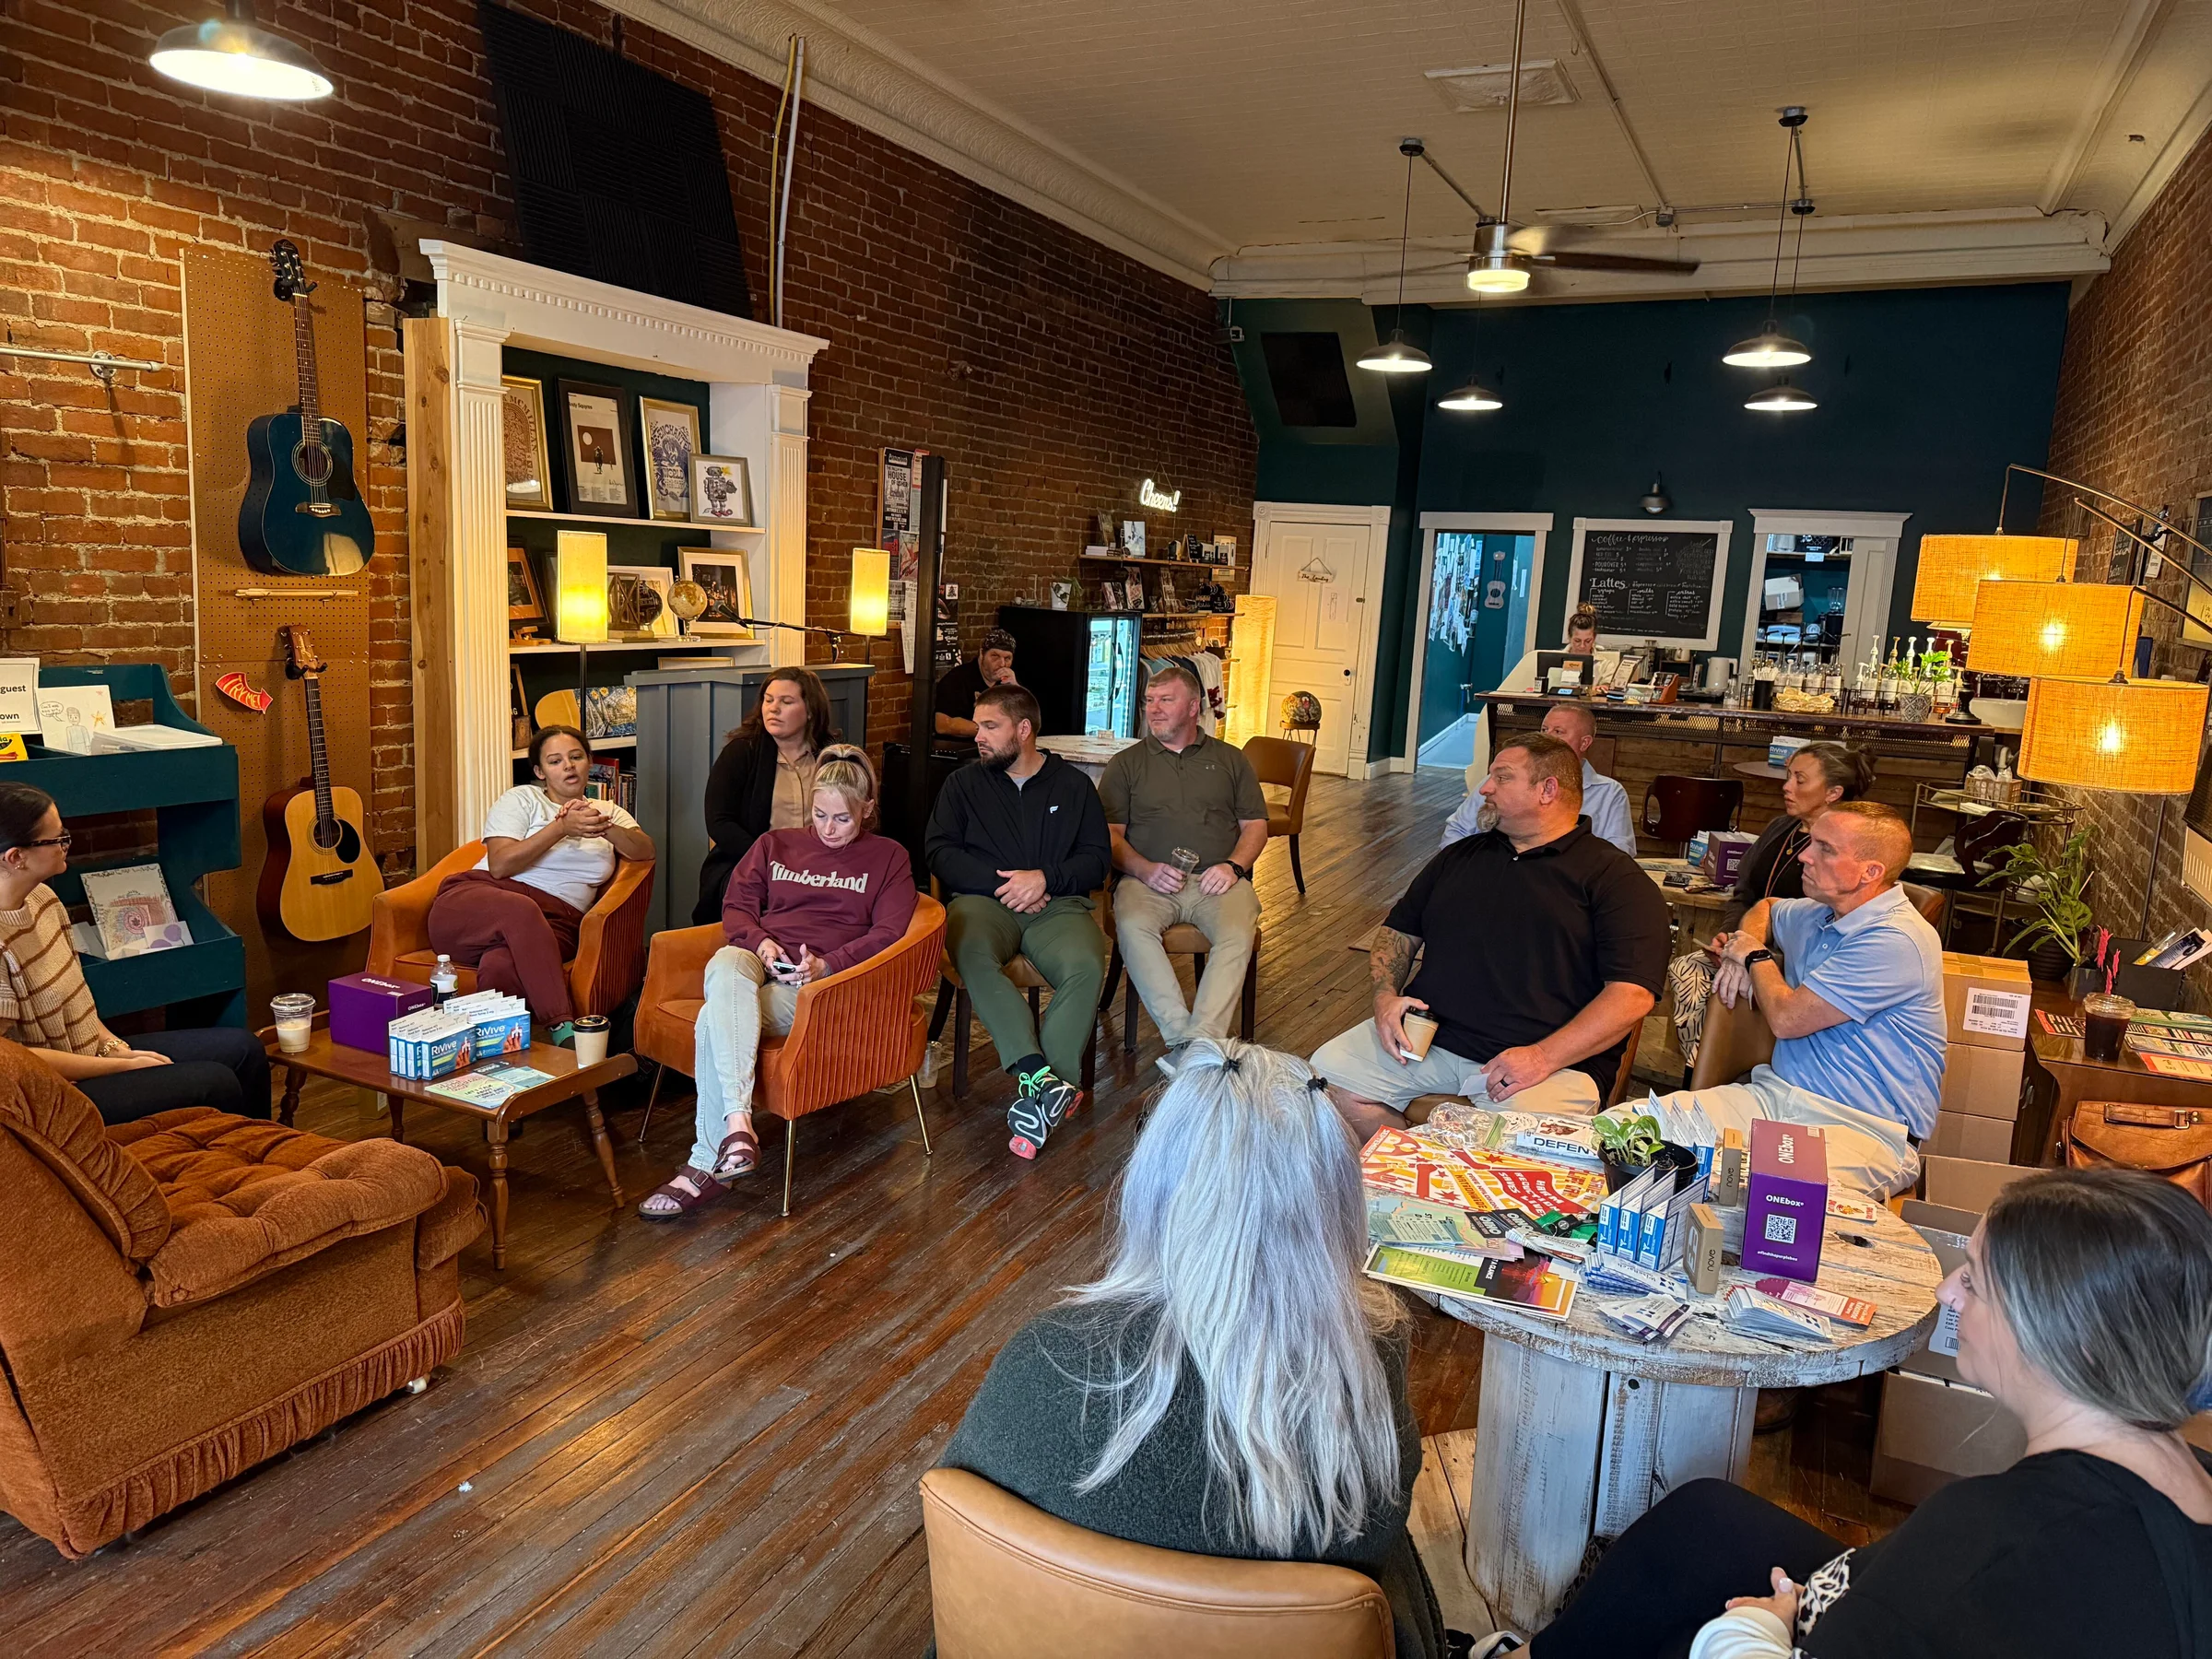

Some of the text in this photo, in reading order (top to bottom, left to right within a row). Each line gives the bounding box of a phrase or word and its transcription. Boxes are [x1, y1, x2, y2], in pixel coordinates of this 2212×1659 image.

[664, 467, 684, 480] WORLD
[888, 471, 906, 481] HOUSE
[1140, 478, 1181, 512] Cheers!
[1590, 578, 1626, 590] Lattes
[223, 675, 248, 701] TRY
[770, 860, 868, 893] Timberland
[431, 1041, 457, 1055] RiVive
[1534, 1137, 1595, 1156] DEFEN
[1454, 1174, 1488, 1209] NATIONWIDE
[1499, 1171, 1521, 1194] SAVES
[1514, 1172, 1561, 1212] REDUCTION
[1535, 1180, 1564, 1204] HARM
[1477, 1185, 1499, 1210] NALOXON
[1521, 1195, 1547, 1217] LIVE
[1478, 1216, 1501, 1235] OHIO
[1707, 1249, 1715, 1272] nove
